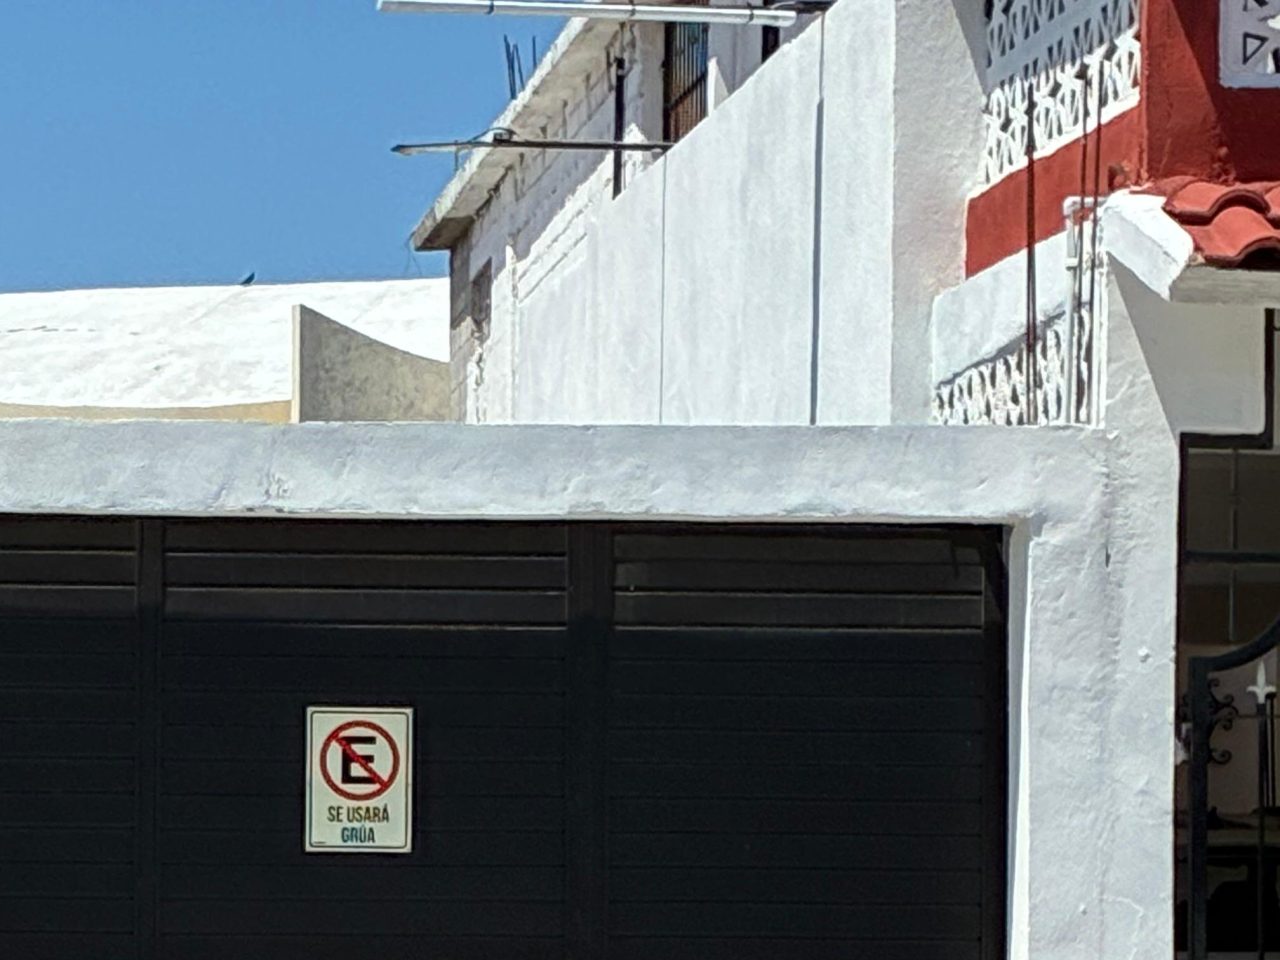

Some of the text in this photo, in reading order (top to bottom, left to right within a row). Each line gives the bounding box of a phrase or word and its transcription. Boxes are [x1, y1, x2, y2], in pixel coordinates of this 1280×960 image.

[339, 736, 376, 784] E
[327, 803, 389, 823] SE USARÁ
[341, 825, 376, 843] GRÚA
